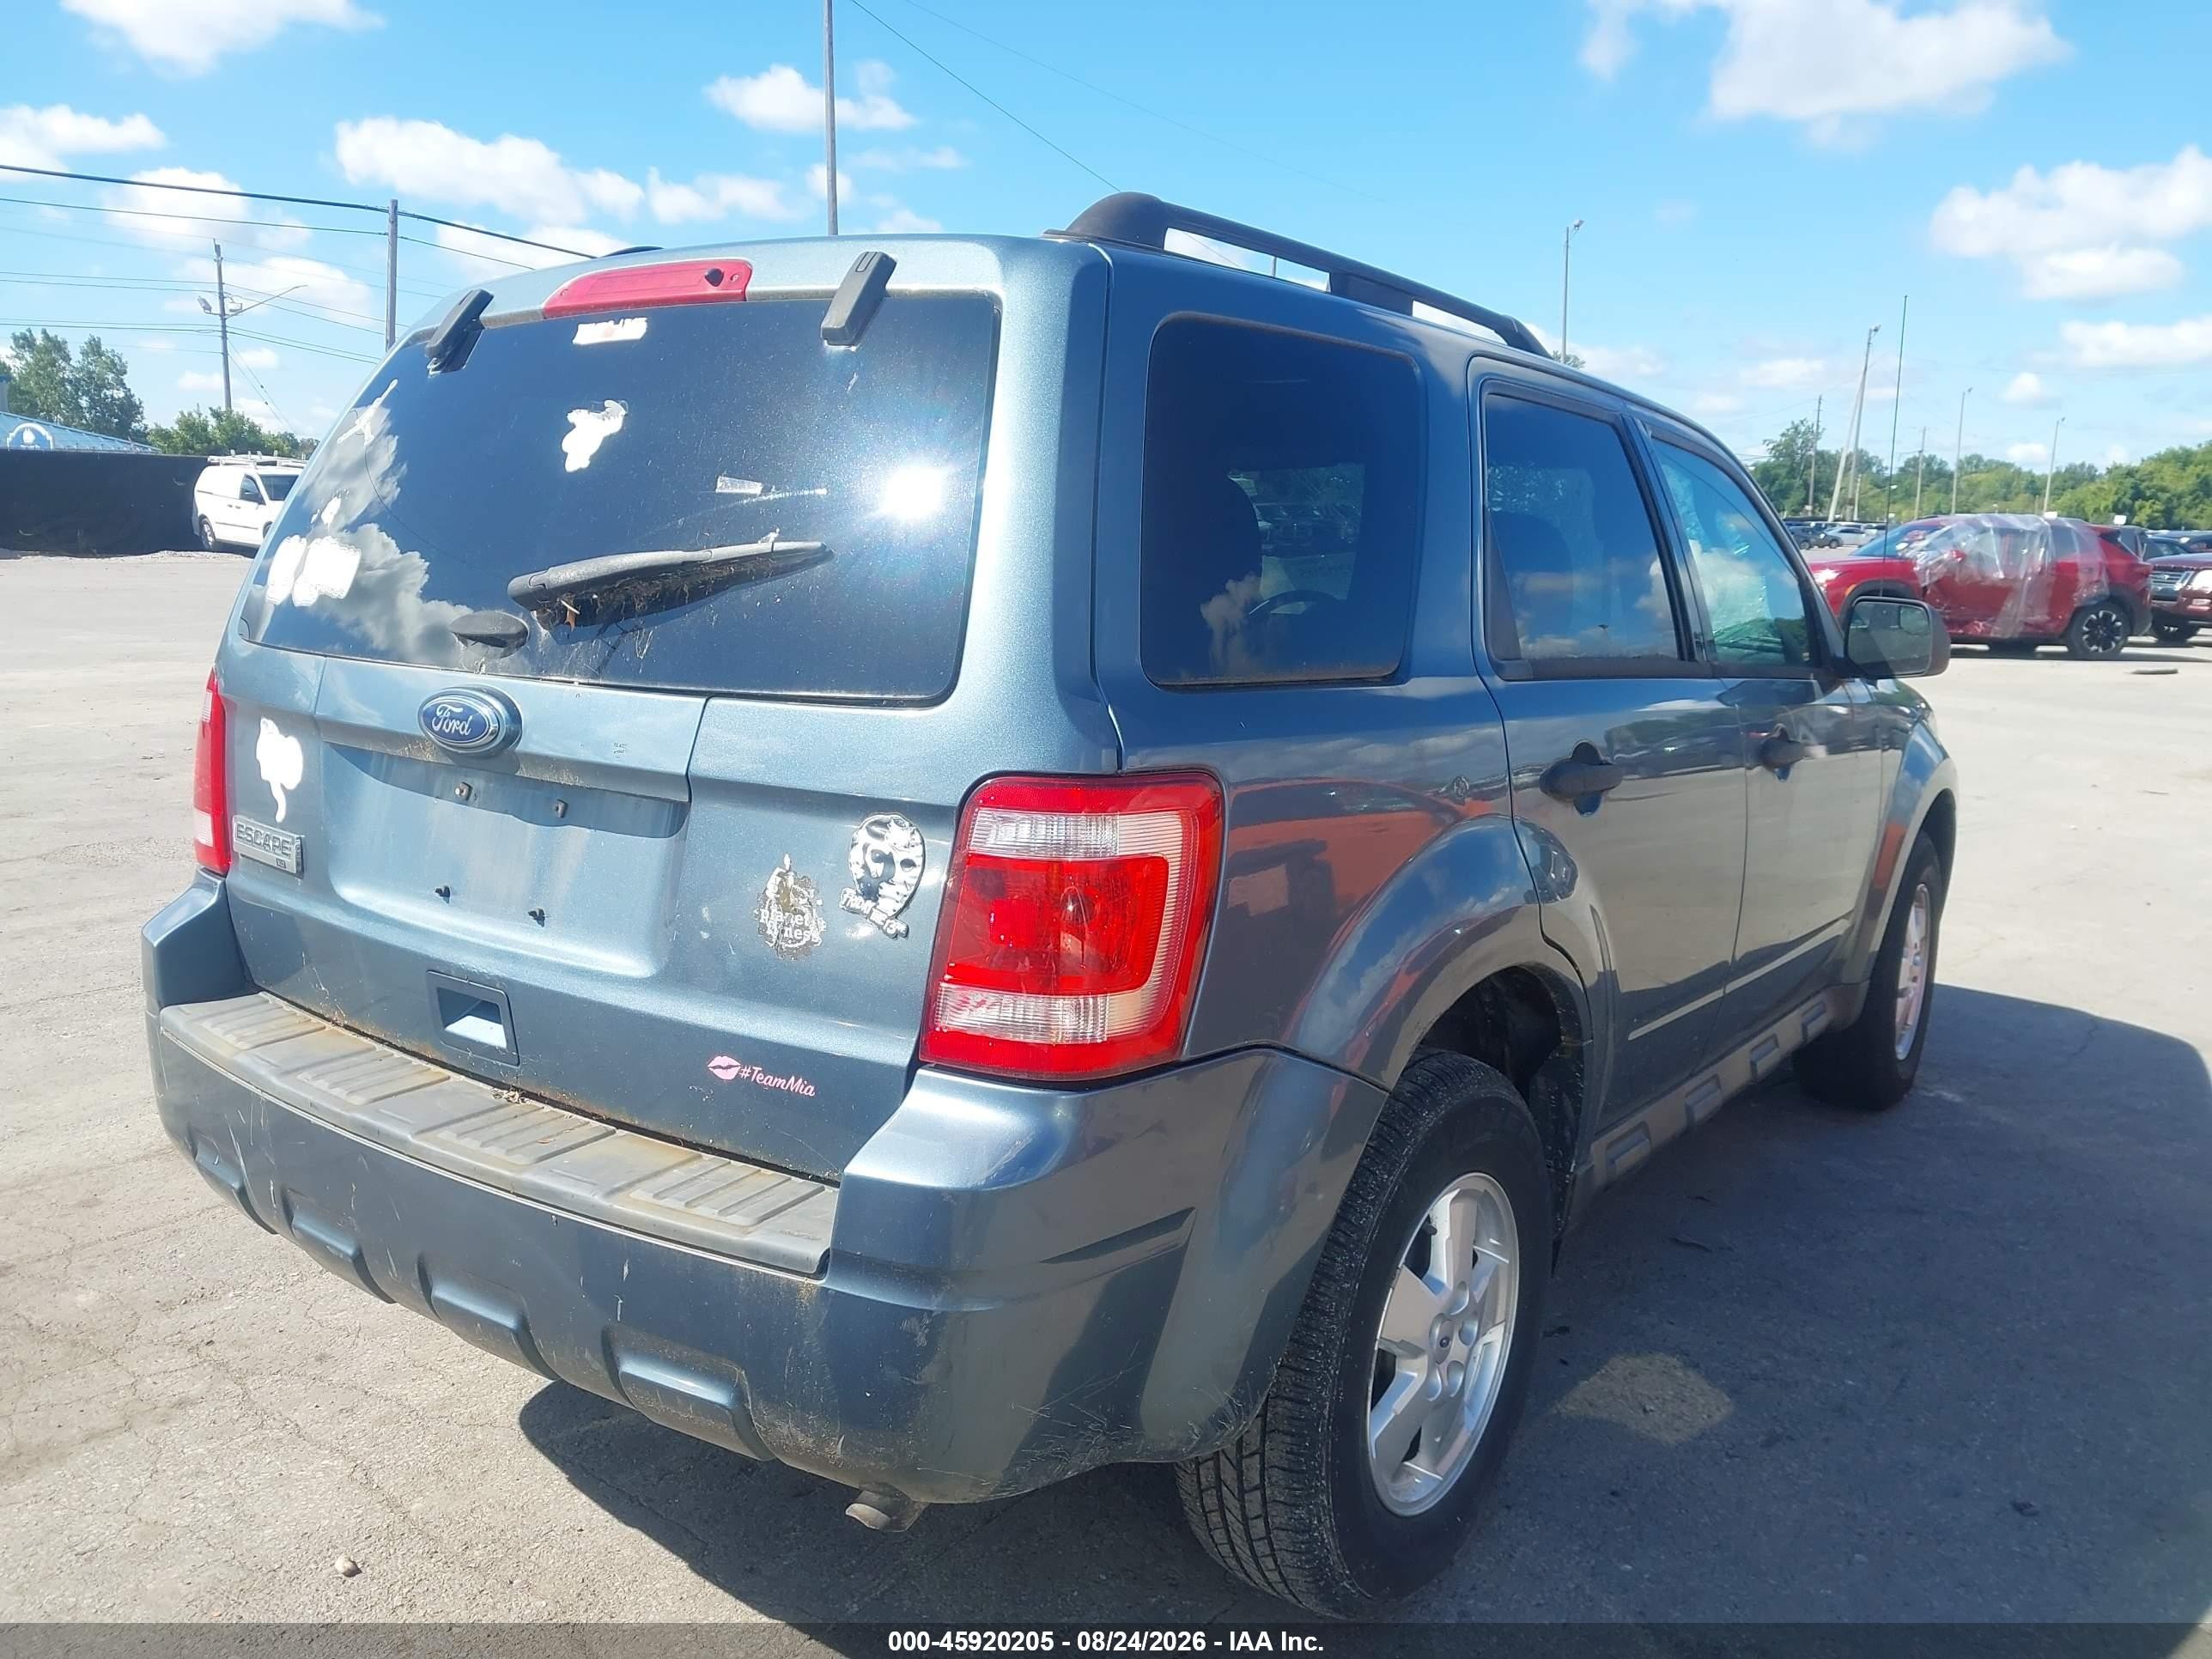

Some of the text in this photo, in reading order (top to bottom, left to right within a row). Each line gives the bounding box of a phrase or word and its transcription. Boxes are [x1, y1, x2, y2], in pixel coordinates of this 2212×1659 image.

[431, 704, 473, 736] Ford
[236, 823, 291, 857] ESCAPE
[739, 1065, 816, 1097] #TeamMia
